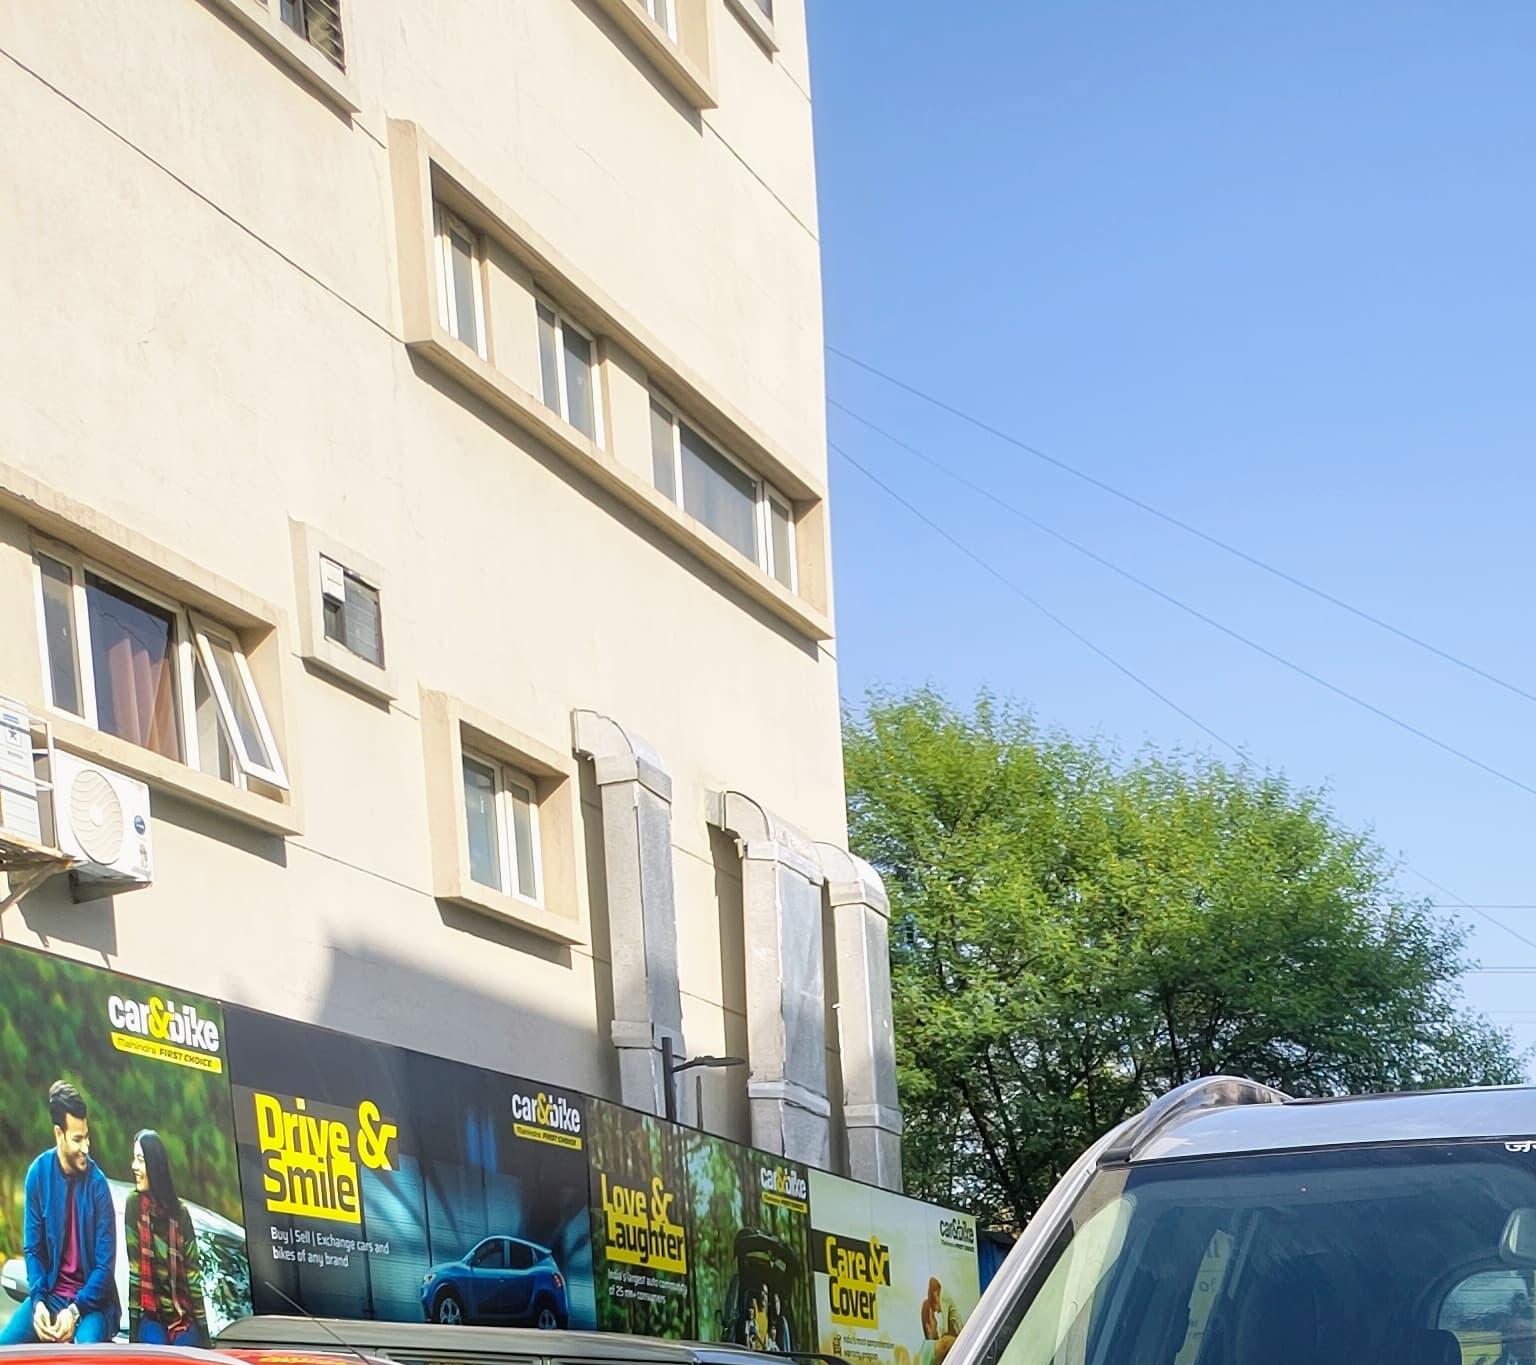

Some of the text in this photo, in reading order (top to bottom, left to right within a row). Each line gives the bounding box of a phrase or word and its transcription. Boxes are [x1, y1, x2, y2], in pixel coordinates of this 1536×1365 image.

[108, 995, 220, 1052] car&bike
[159, 1047, 182, 1061] FIRST
[254, 1092, 397, 1171] Drive &
[511, 1092, 581, 1133] car&bike
[262, 1148, 357, 1213] Smile
[600, 1173, 674, 1226] Love &
[760, 1166, 807, 1199] car&bike
[270, 1226, 390, 1255] Buy Sell Exchange cars and
[272, 1246, 349, 1268] bikes of any brand
[605, 1216, 684, 1264] Laughter
[825, 1235, 889, 1286] Care &
[829, 1275, 876, 1321] Cover
